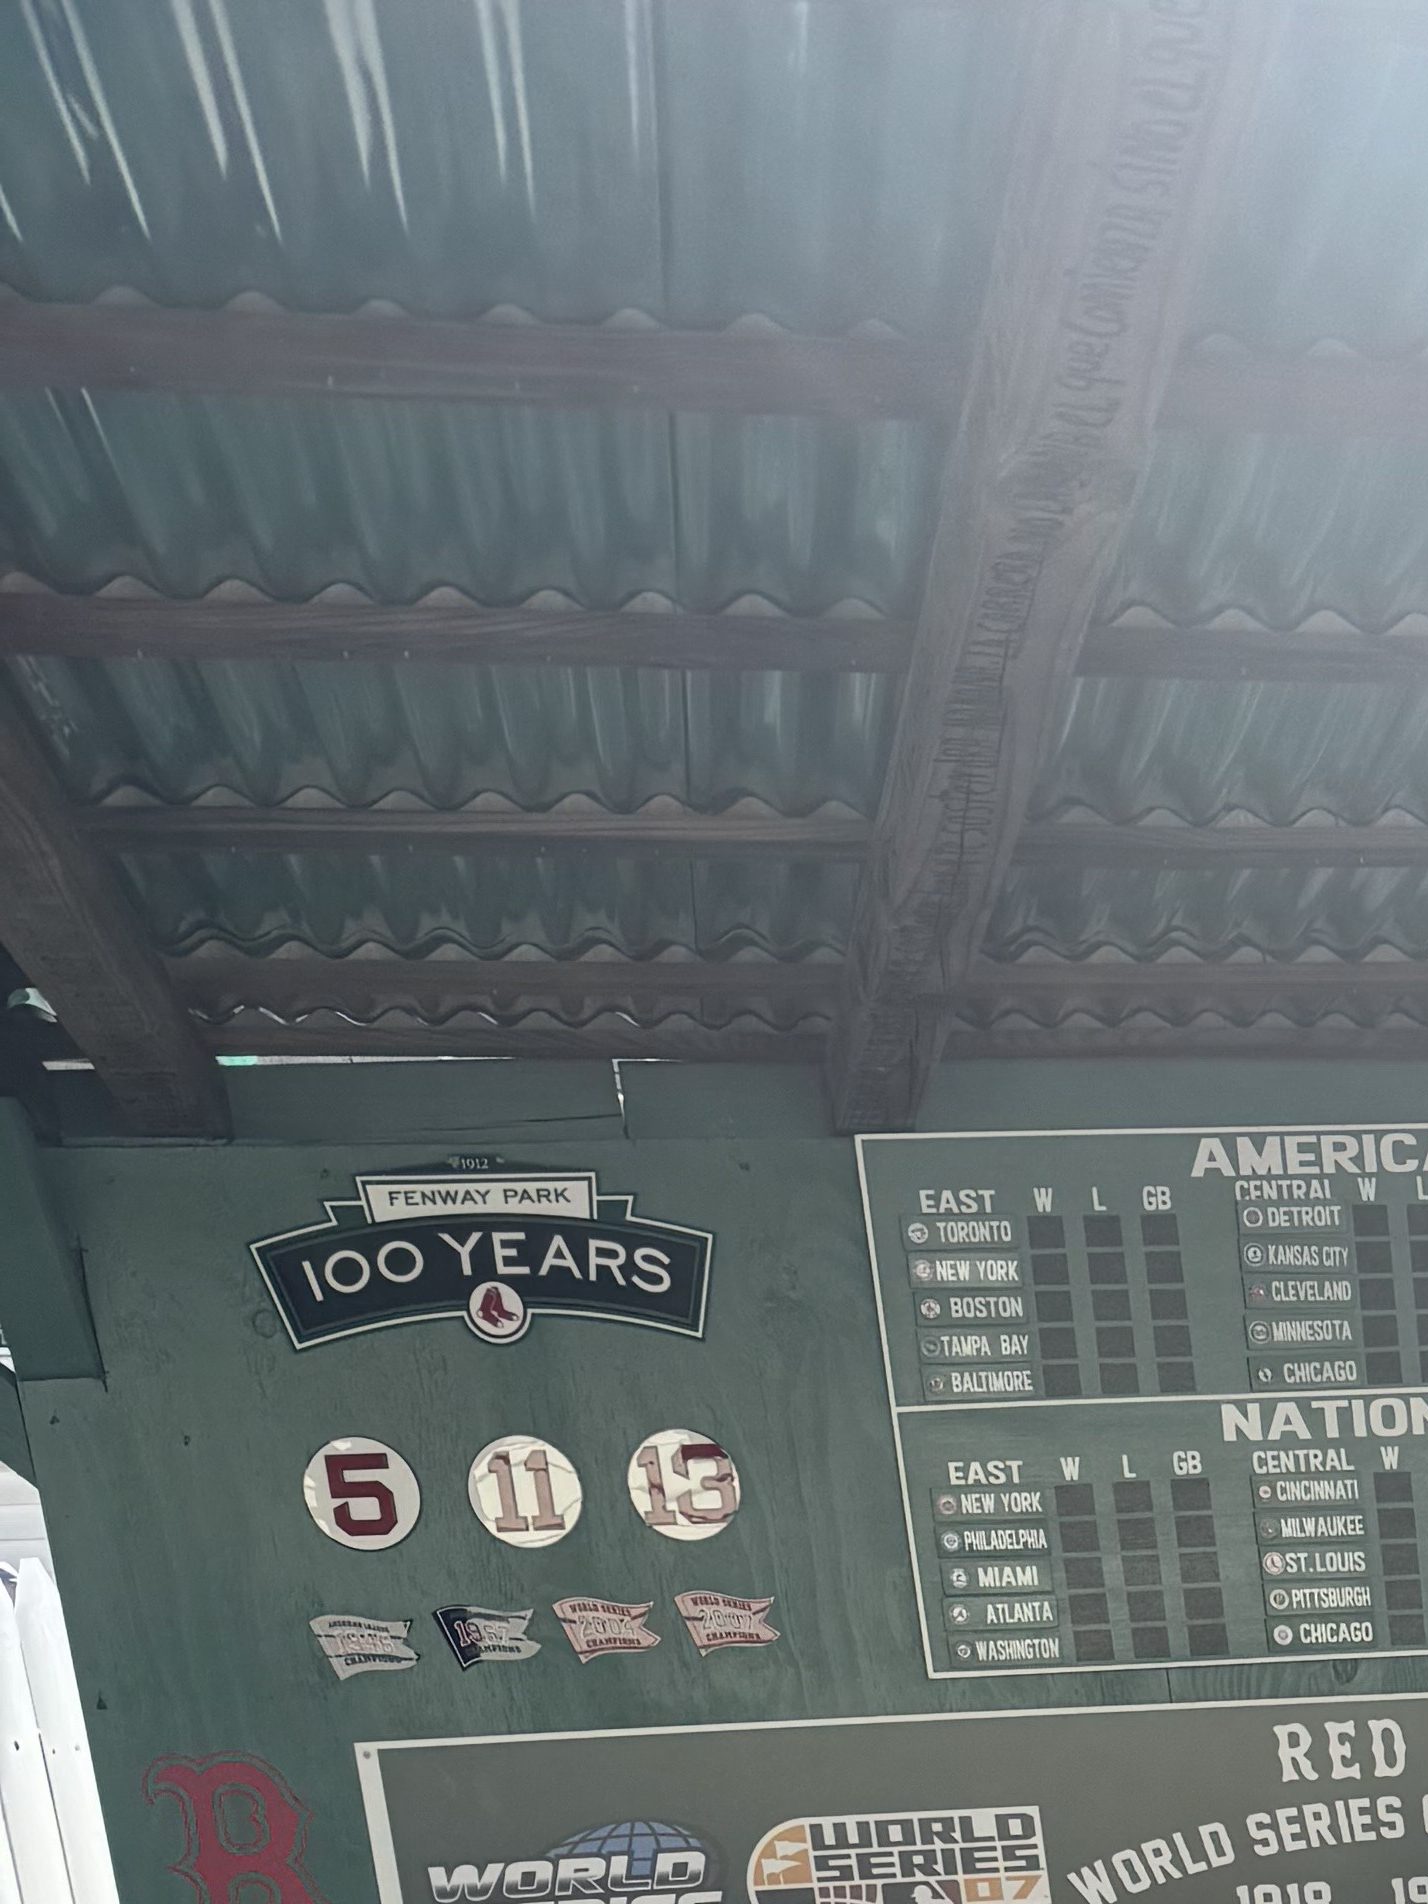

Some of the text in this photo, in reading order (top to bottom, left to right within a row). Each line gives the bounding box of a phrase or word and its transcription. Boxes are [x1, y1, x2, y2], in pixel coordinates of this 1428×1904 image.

[460, 1157, 489, 1170] 1912
[387, 1187, 571, 1207] FENWAY PARK
[919, 1185, 1172, 1214] EAST W L GB
[1358, 1177, 1376, 1201] W
[1267, 1205, 1341, 1228] DETROIT
[936, 1220, 1012, 1243] TORONTO
[301, 1231, 673, 1302] 100 YEARS
[1268, 1245, 1349, 1267] KANSAS CITY
[935, 1259, 1019, 1282] NEW YORK
[1271, 1280, 1351, 1302] CLEVELAND
[949, 1296, 1024, 1319] BOSTON
[1271, 1320, 1352, 1342] MINNESOTA
[940, 1334, 1029, 1357] TAMPA BAY
[951, 1370, 1033, 1393] BALTIMORE
[1283, 1360, 1357, 1384] CHICAGO
[947, 1450, 1202, 1486] EAST W L GB
[1252, 1447, 1355, 1475] CENTRAL
[1380, 1446, 1400, 1471] W
[323, 1452, 399, 1537] 5
[484, 1448, 567, 1533] 11
[1276, 1479, 1359, 1502] CINCINNATI
[960, 1491, 1042, 1514] NEW YORK
[1280, 1514, 1365, 1538] MILWAUKEE
[963, 1528, 1048, 1551] PHILADELPHIA
[977, 1565, 1039, 1588] MIAMI
[1291, 1586, 1371, 1609] PITTSBURGH
[986, 1601, 1054, 1625] ATLANTA
[1299, 1621, 1373, 1644] CHICAGO
[975, 1637, 1060, 1662] WASHINGTON
[1273, 1718, 1407, 1783] RED
[810, 1811, 1037, 1851] WORLD
[1245, 1795, 1405, 1859] SERIES
[814, 1843, 1044, 1880] SERIES
[427, 1850, 707, 1904] WORLD
[965, 1875, 1044, 1903] 07
